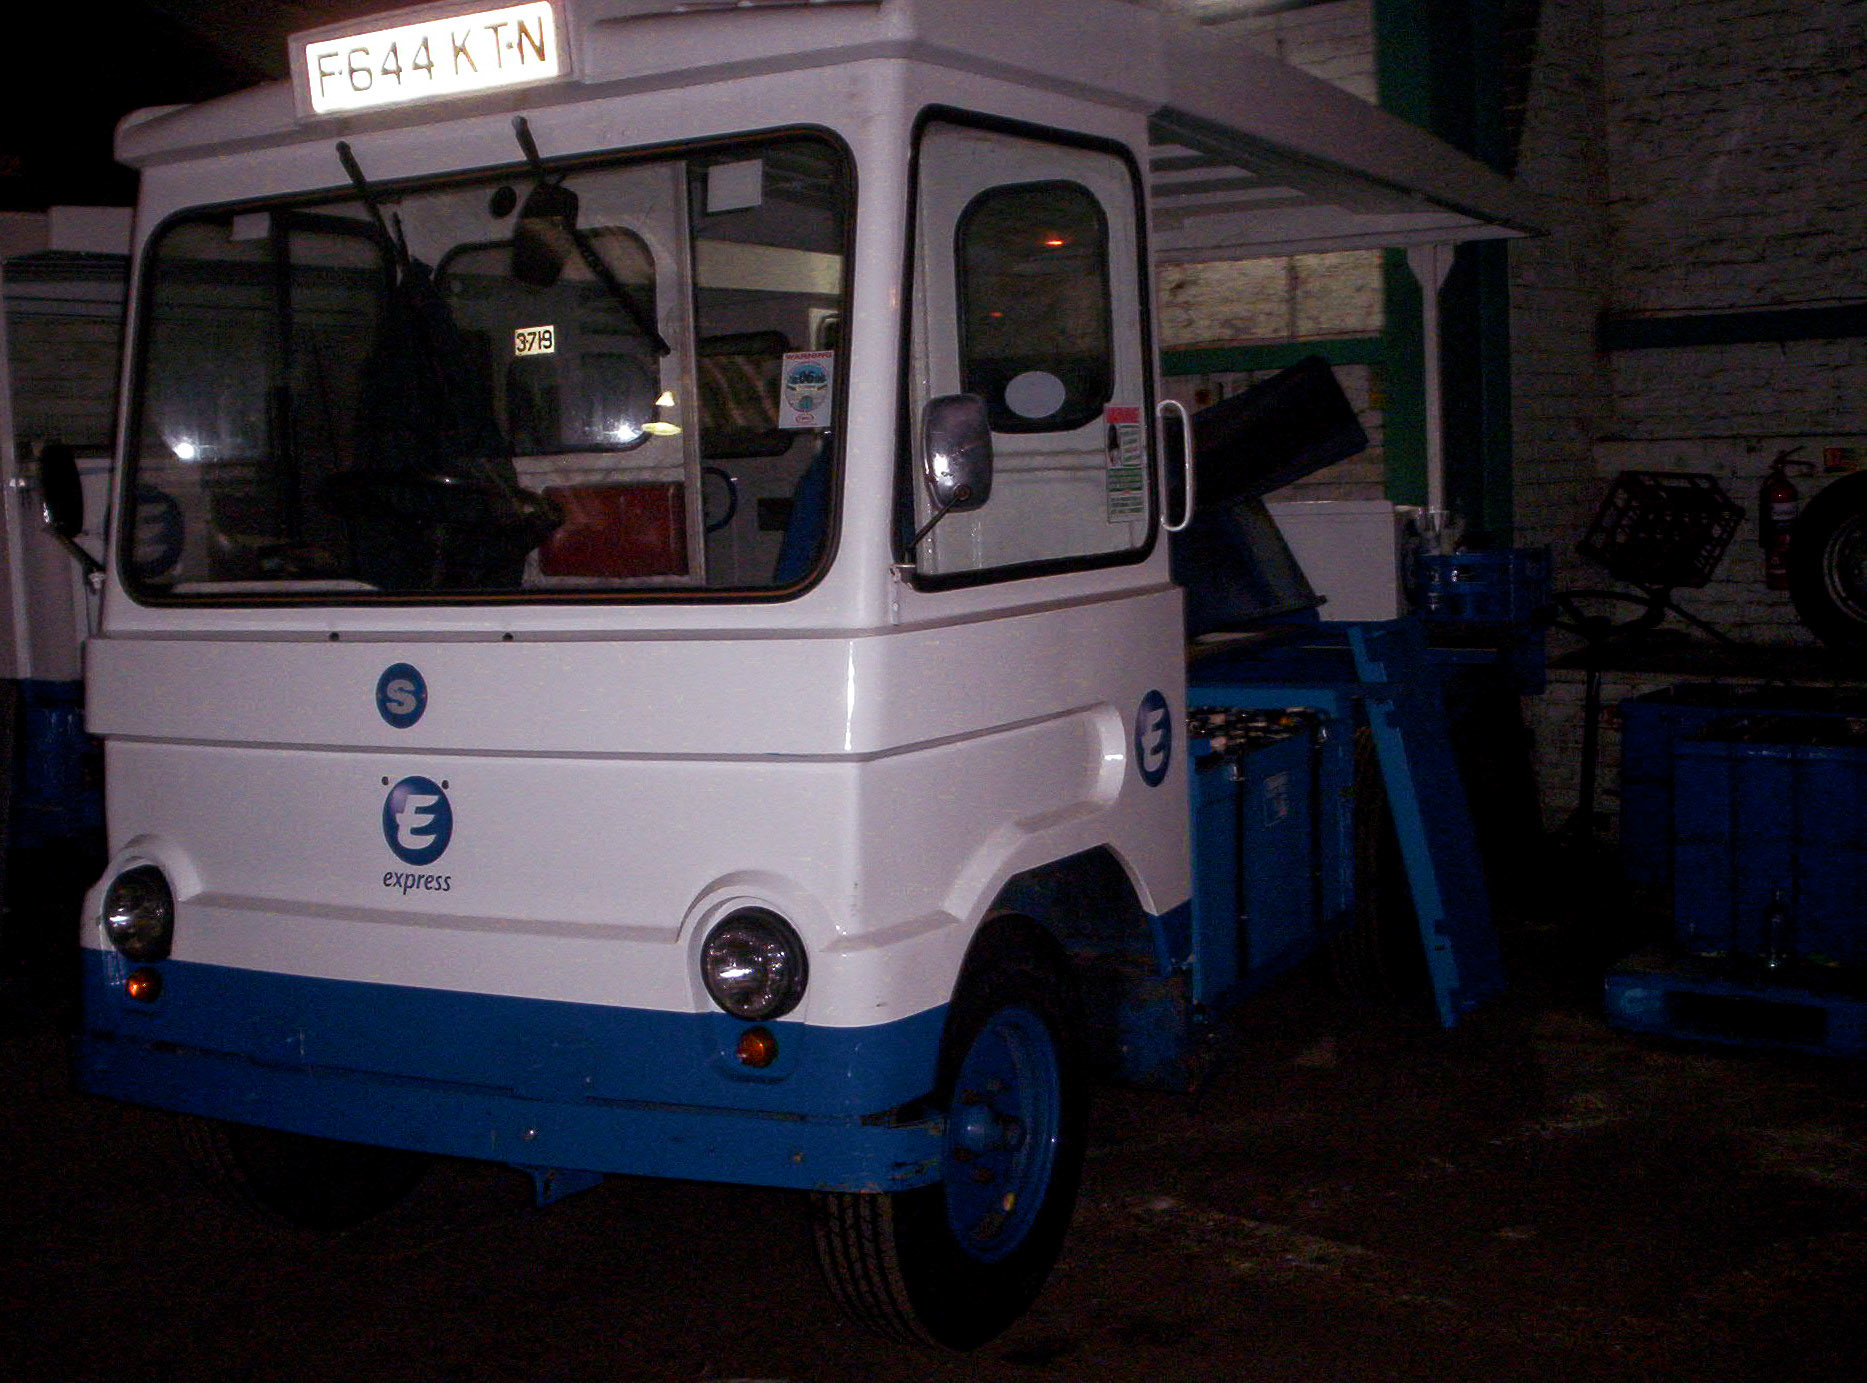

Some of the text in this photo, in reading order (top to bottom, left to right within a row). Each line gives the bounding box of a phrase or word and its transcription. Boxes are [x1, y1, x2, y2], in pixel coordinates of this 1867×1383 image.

[516, 329, 553, 353] 3719
[386, 679, 418, 714] S
[383, 872, 451, 894] express
